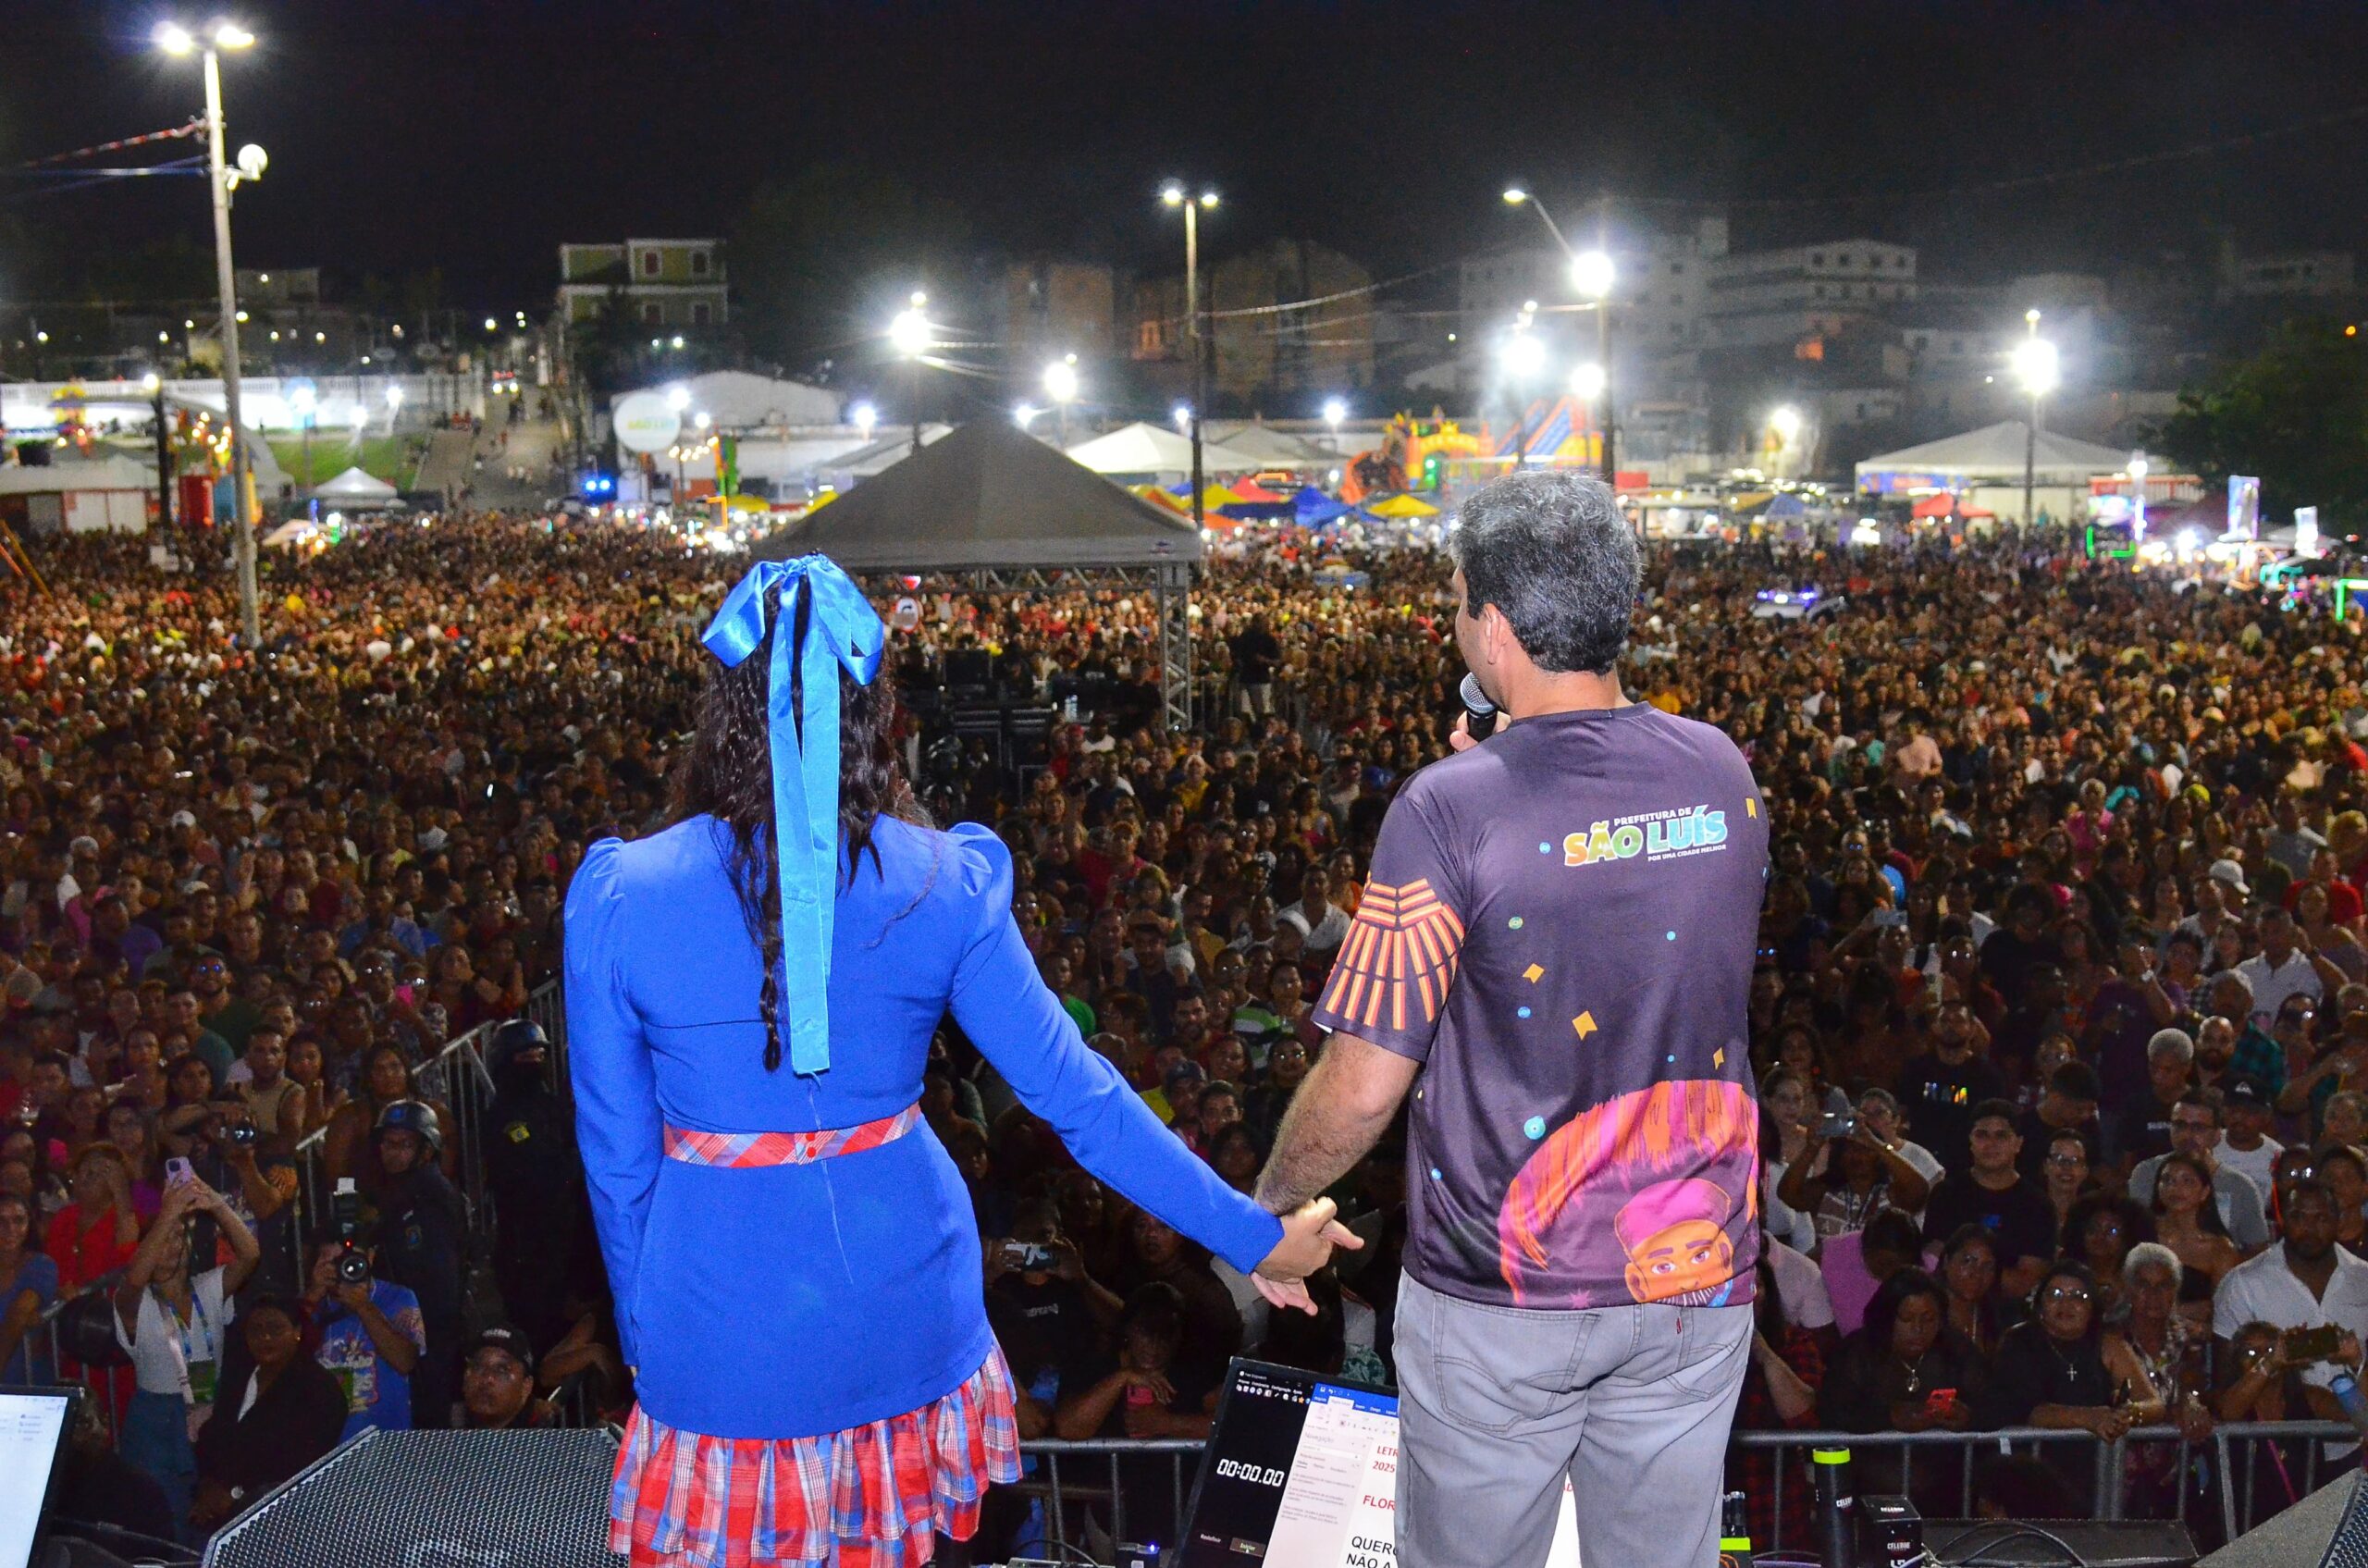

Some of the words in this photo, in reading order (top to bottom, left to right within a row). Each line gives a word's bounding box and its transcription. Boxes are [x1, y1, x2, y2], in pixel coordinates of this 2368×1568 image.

[1614, 809, 1676, 826] PREFEITURA
[1678, 807, 1692, 817] DE
[1564, 821, 1644, 866] SÃO
[1646, 804, 1728, 855] LUÍS
[1677, 848, 1700, 857] CIDADE
[1700, 844, 1727, 854] MELHOR
[1216, 1459, 1285, 1487] 00:00.00
[1373, 1460, 1396, 1474] 2025
[1363, 1494, 1395, 1511] FLOR
[1346, 1552, 1378, 1568] NÃO
